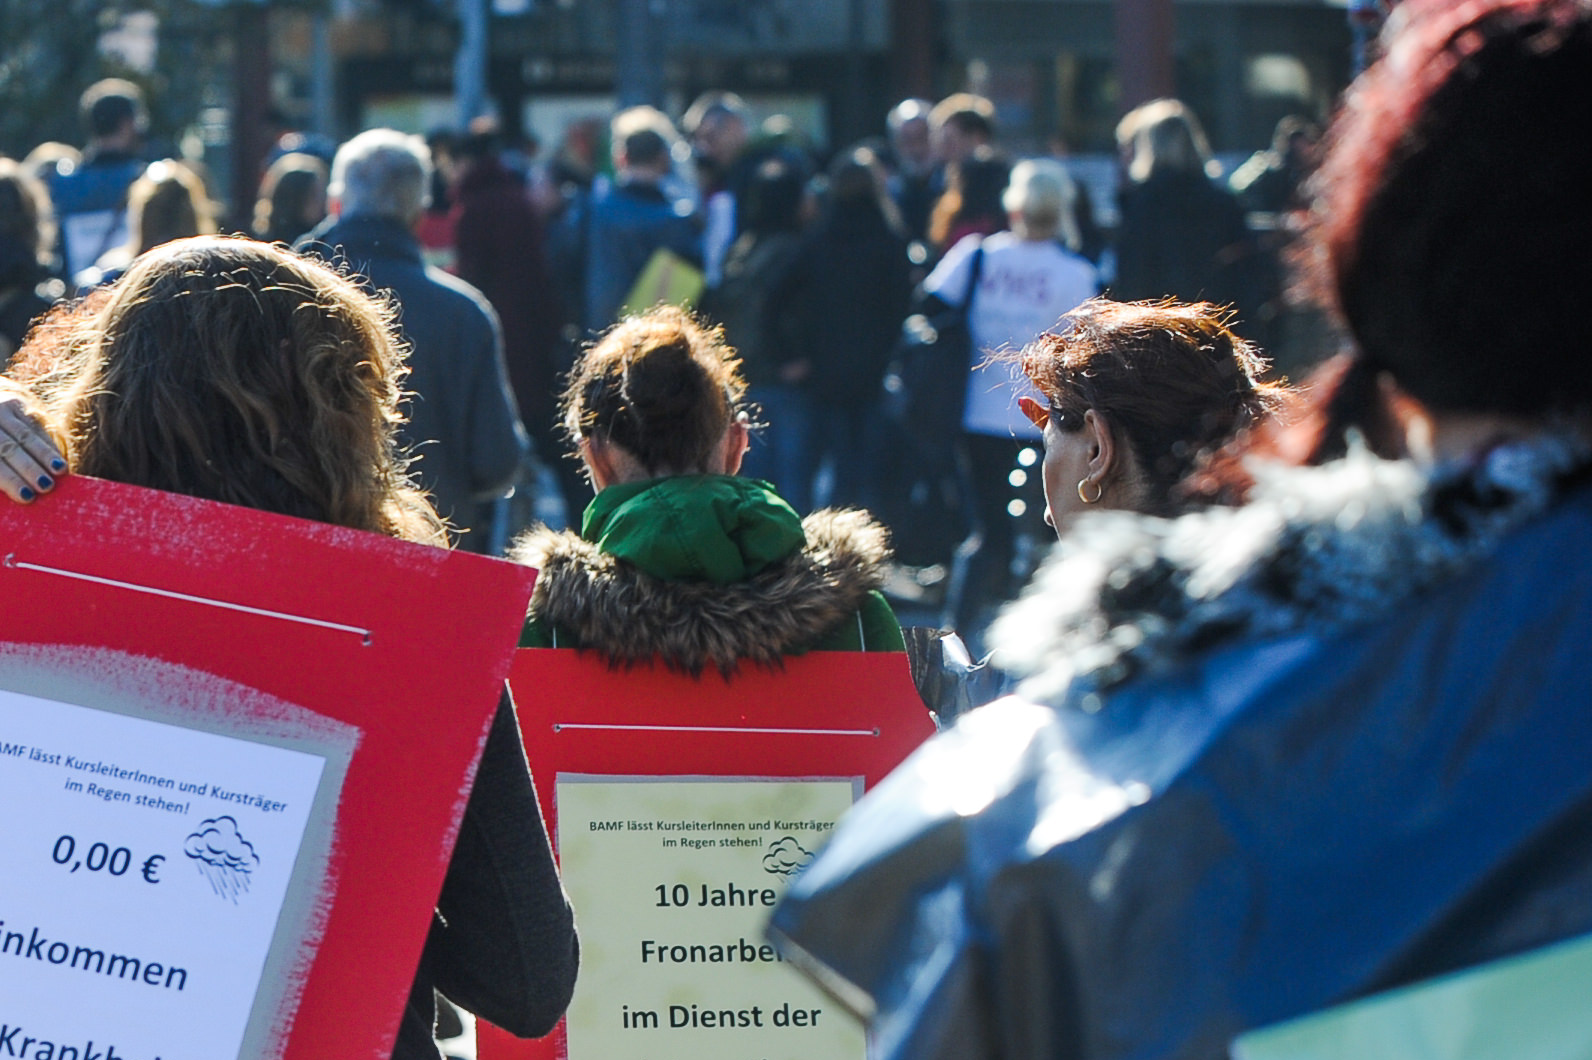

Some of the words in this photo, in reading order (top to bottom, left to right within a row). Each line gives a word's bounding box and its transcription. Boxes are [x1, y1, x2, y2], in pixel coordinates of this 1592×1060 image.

[28, 747, 62, 766] lässt
[64, 755, 175, 790] KursleiterInnen
[178, 781, 208, 796] und
[209, 785, 288, 813] Kursträger
[64, 777, 84, 793] im
[86, 782, 132, 803] Regen
[135, 794, 191, 815] stehen!
[589, 820, 625, 832] BAMF
[626, 820, 654, 831] lässt
[656, 819, 746, 832] KursleiterInnen
[748, 819, 771, 831] und
[773, 819, 836, 835] Kursträger
[662, 836, 678, 848] im
[680, 837, 717, 850] Regen
[718, 835, 763, 848] stehen!
[51, 834, 133, 877] 0,00
[140, 853, 167, 885] €
[654, 883, 690, 908] 10
[697, 881, 777, 908] Jahre
[622, 1004, 659, 1030] im
[668, 1003, 764, 1029] Dienst
[772, 1002, 822, 1028] der
